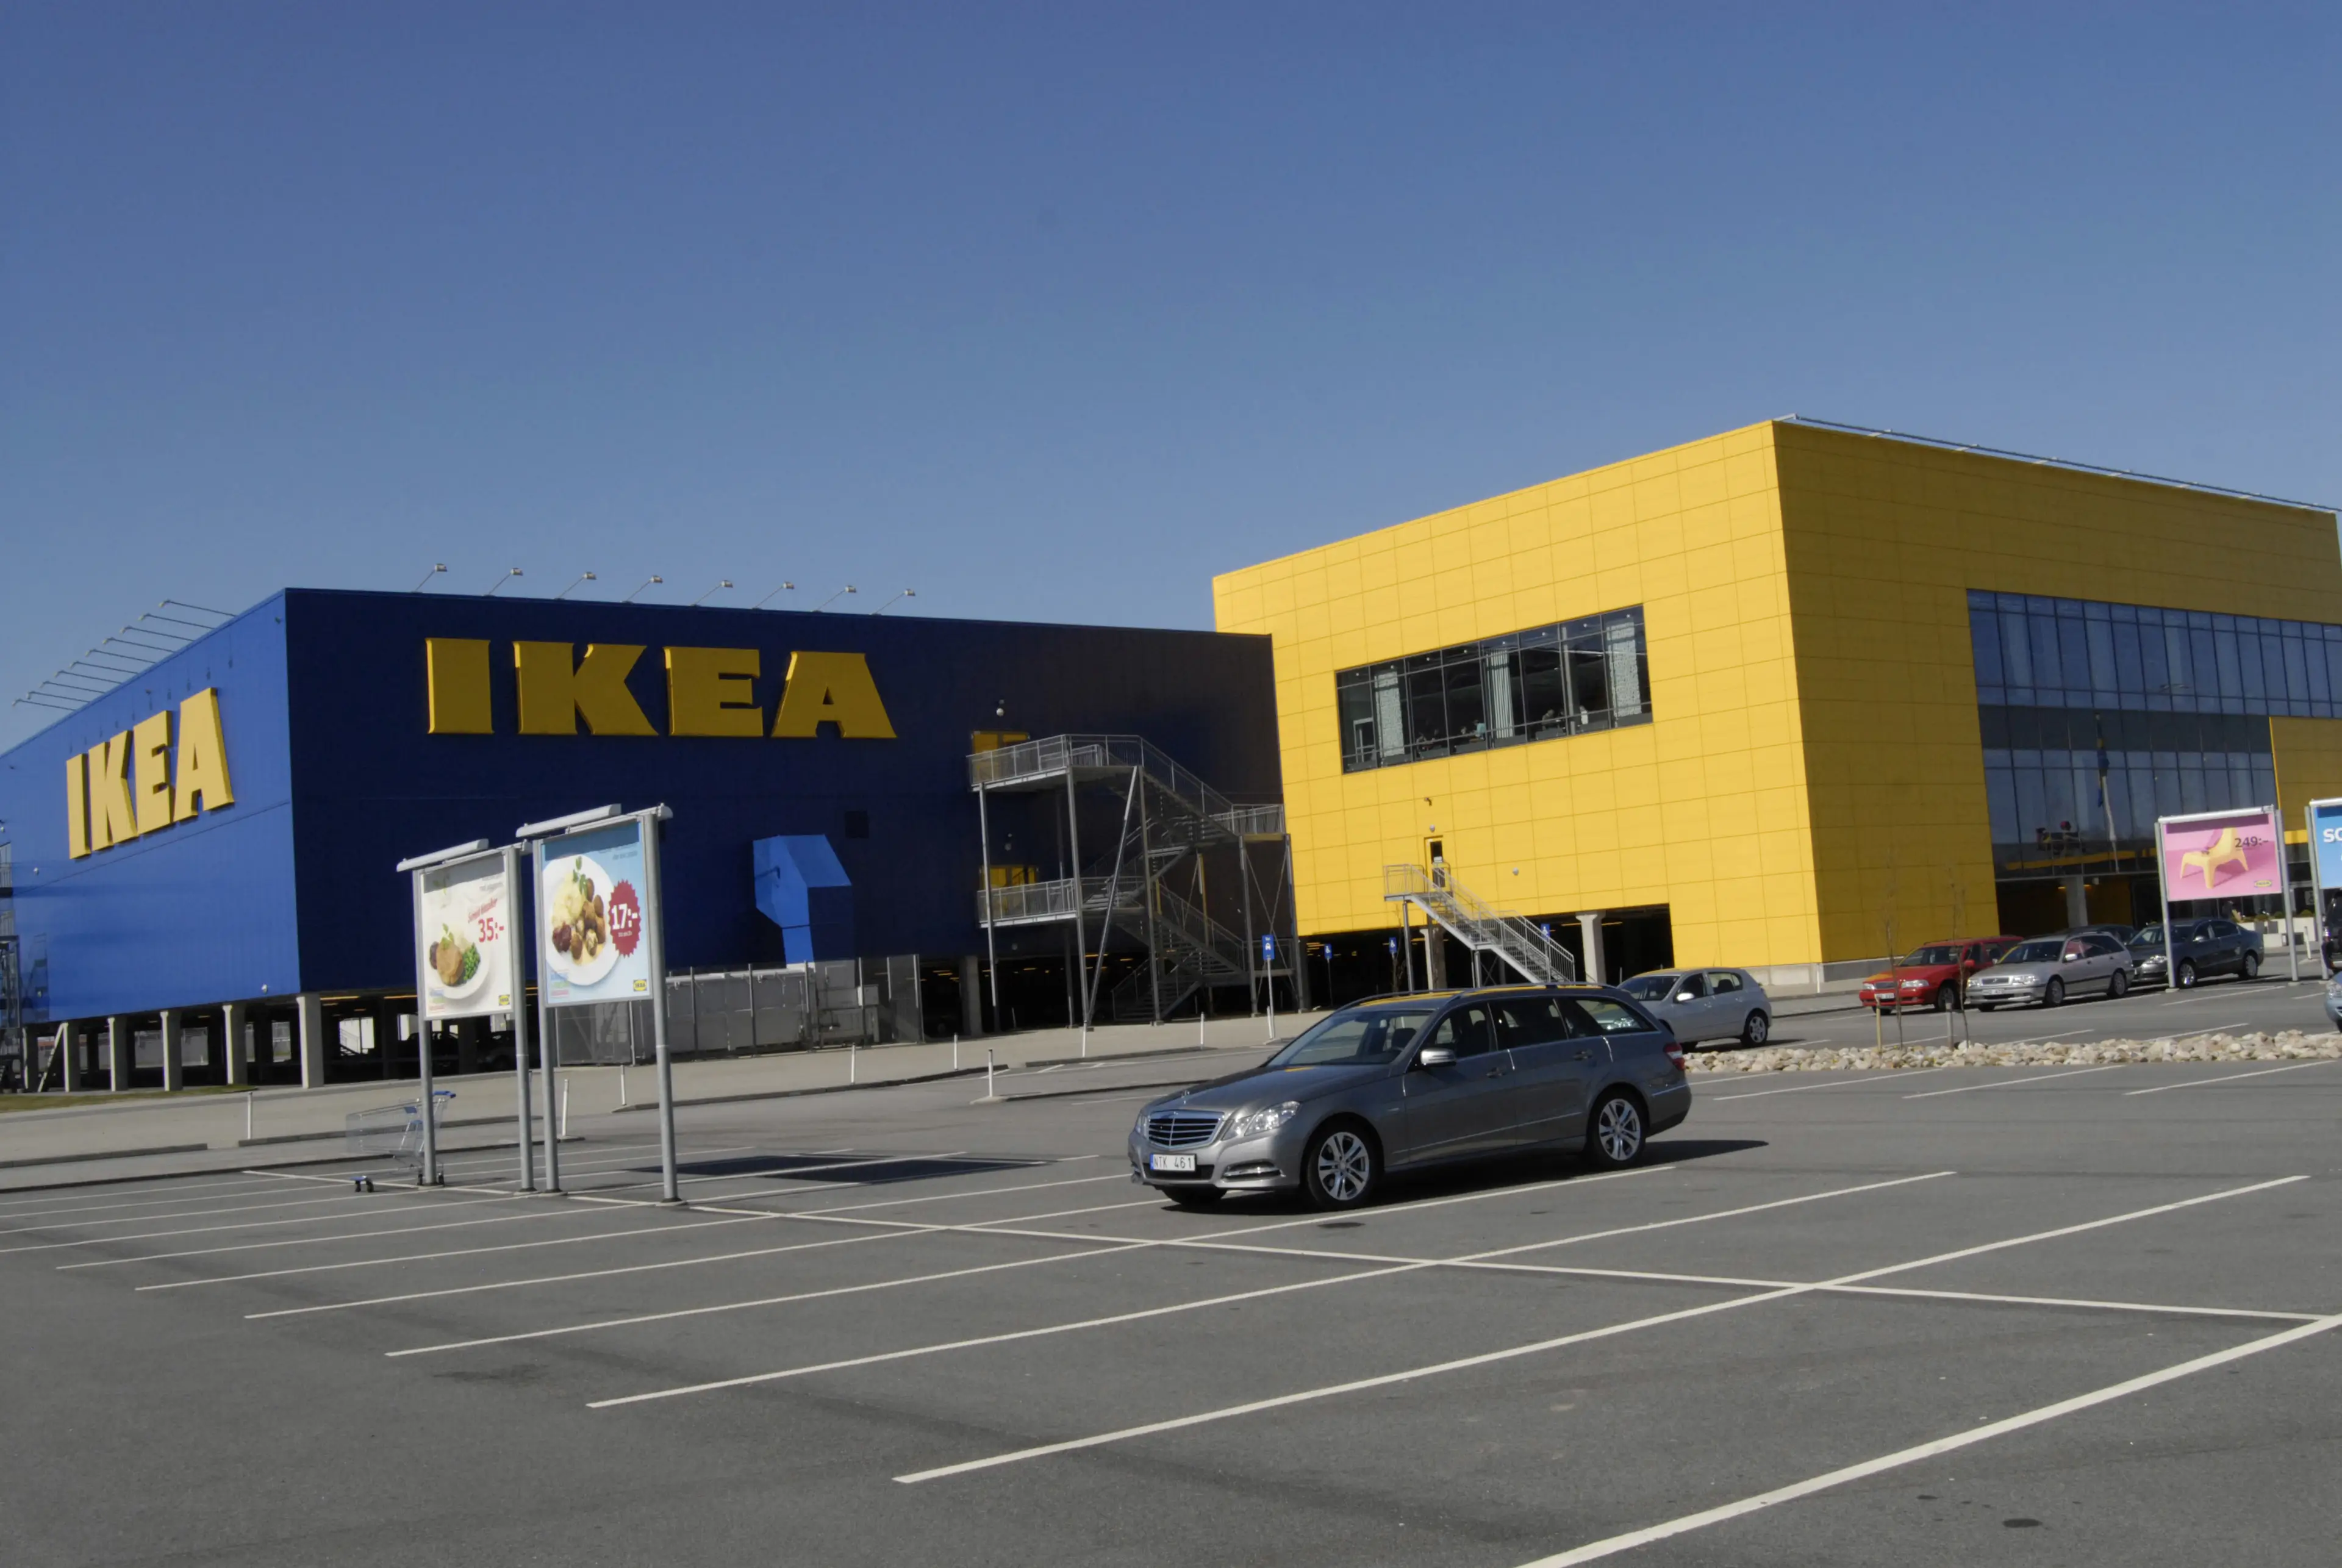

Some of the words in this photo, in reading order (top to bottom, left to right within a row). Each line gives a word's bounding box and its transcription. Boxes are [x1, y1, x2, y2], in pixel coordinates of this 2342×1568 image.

[426, 639, 898, 739] IKEA
[66, 687, 235, 859] IKEA
[2234, 836, 2269, 848] 249:-
[611, 903, 638, 930] 17:-
[478, 917, 504, 943] 35:-
[1153, 1156, 1167, 1169] NTK
[1174, 1157, 1191, 1169] 461
